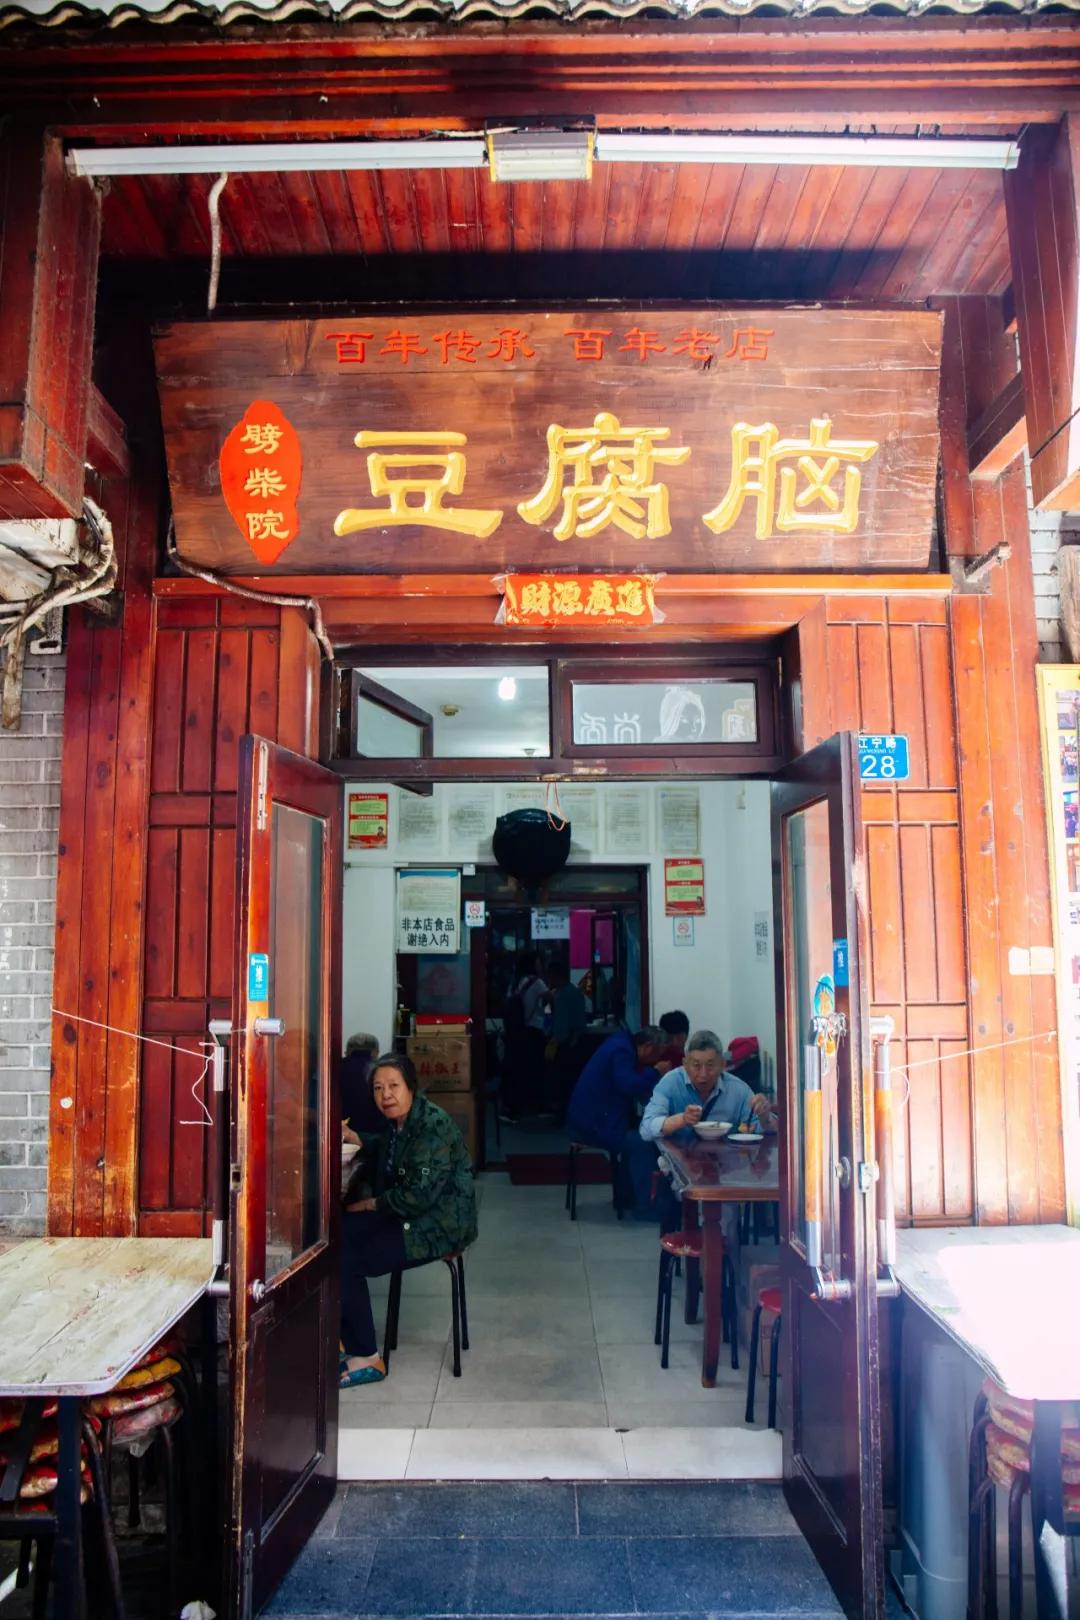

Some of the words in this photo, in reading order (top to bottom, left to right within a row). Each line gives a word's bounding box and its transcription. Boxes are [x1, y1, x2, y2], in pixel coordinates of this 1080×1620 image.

[326, 329, 536, 364] 百年传承
[564, 327, 775, 363] 百年老店
[240, 422, 290, 541] 劈柴院
[333, 411, 880, 541] 豆腐脑
[861, 755, 896, 778] 28
[401, 917, 455, 931] 非本店食品
[407, 933, 450, 947] 谢绝入内
